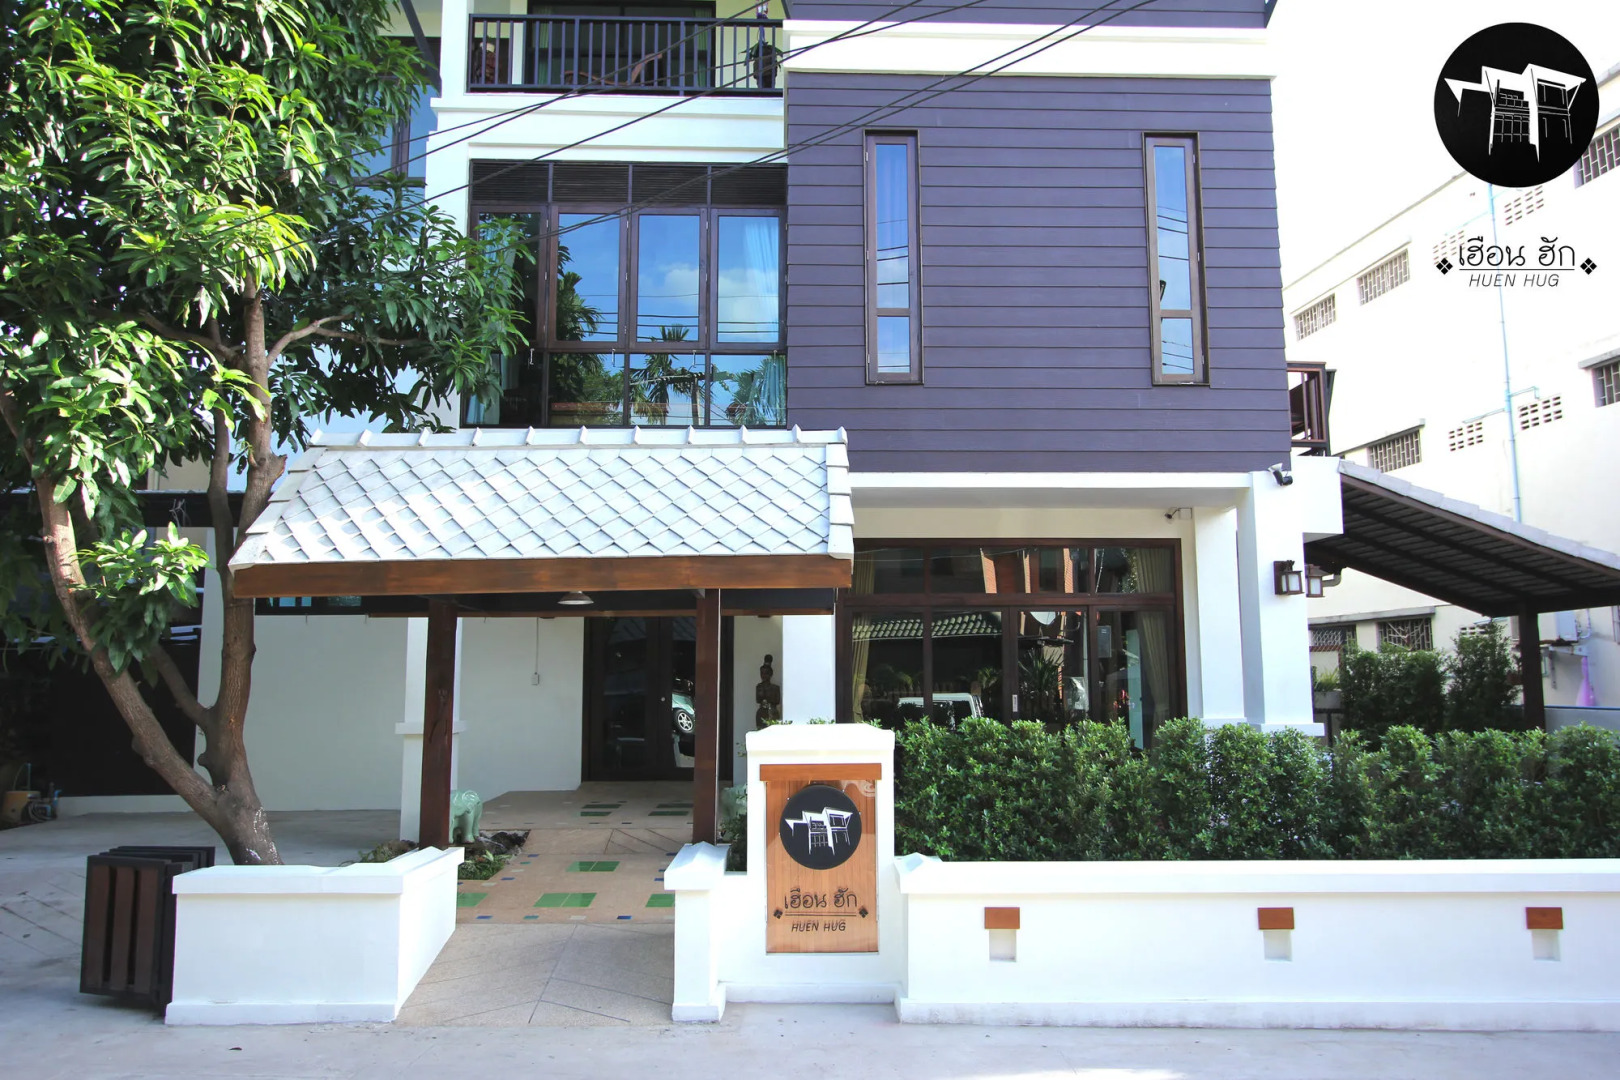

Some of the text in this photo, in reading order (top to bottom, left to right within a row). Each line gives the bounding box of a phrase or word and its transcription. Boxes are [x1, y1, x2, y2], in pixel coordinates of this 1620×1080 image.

[784, 887, 857, 909] เฮือน ฮัก
[791, 920, 846, 932] HUEN HUG
